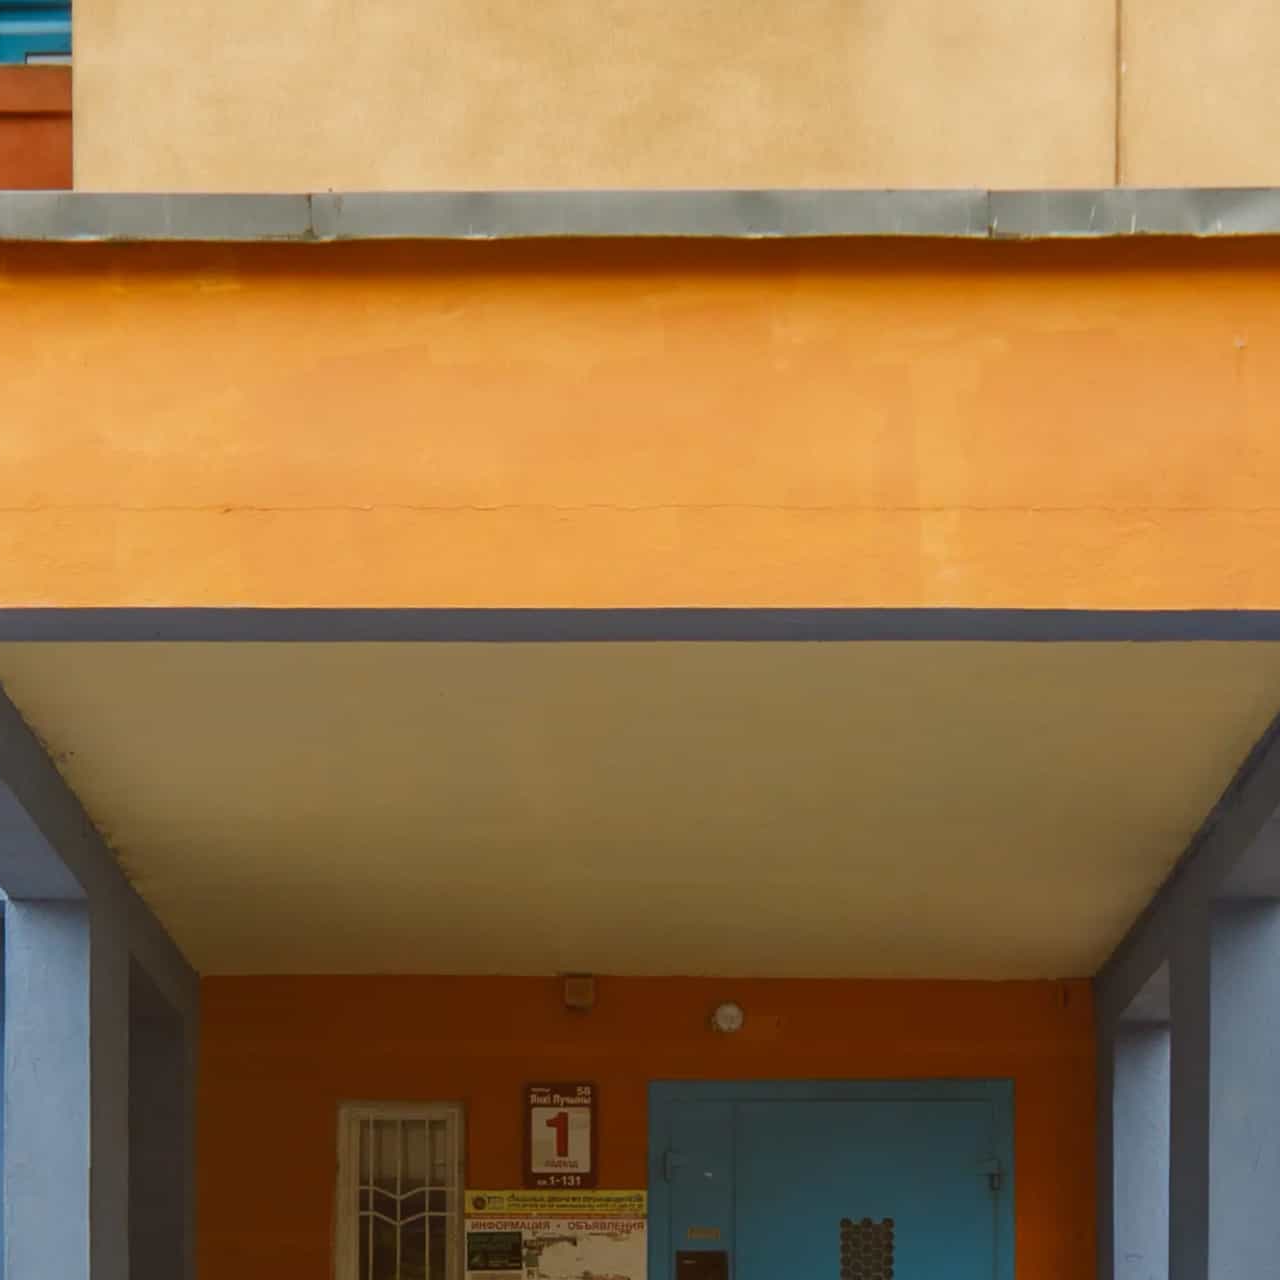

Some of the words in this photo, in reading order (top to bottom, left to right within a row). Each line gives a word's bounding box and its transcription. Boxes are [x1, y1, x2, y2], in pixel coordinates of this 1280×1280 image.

[545, 1111, 568, 1157] 1
[471, 1221, 550, 1231] ИНФОРМАЦИЯ
[568, 1221, 645, 1231] ОБЪЯВЛЕНИЯ
